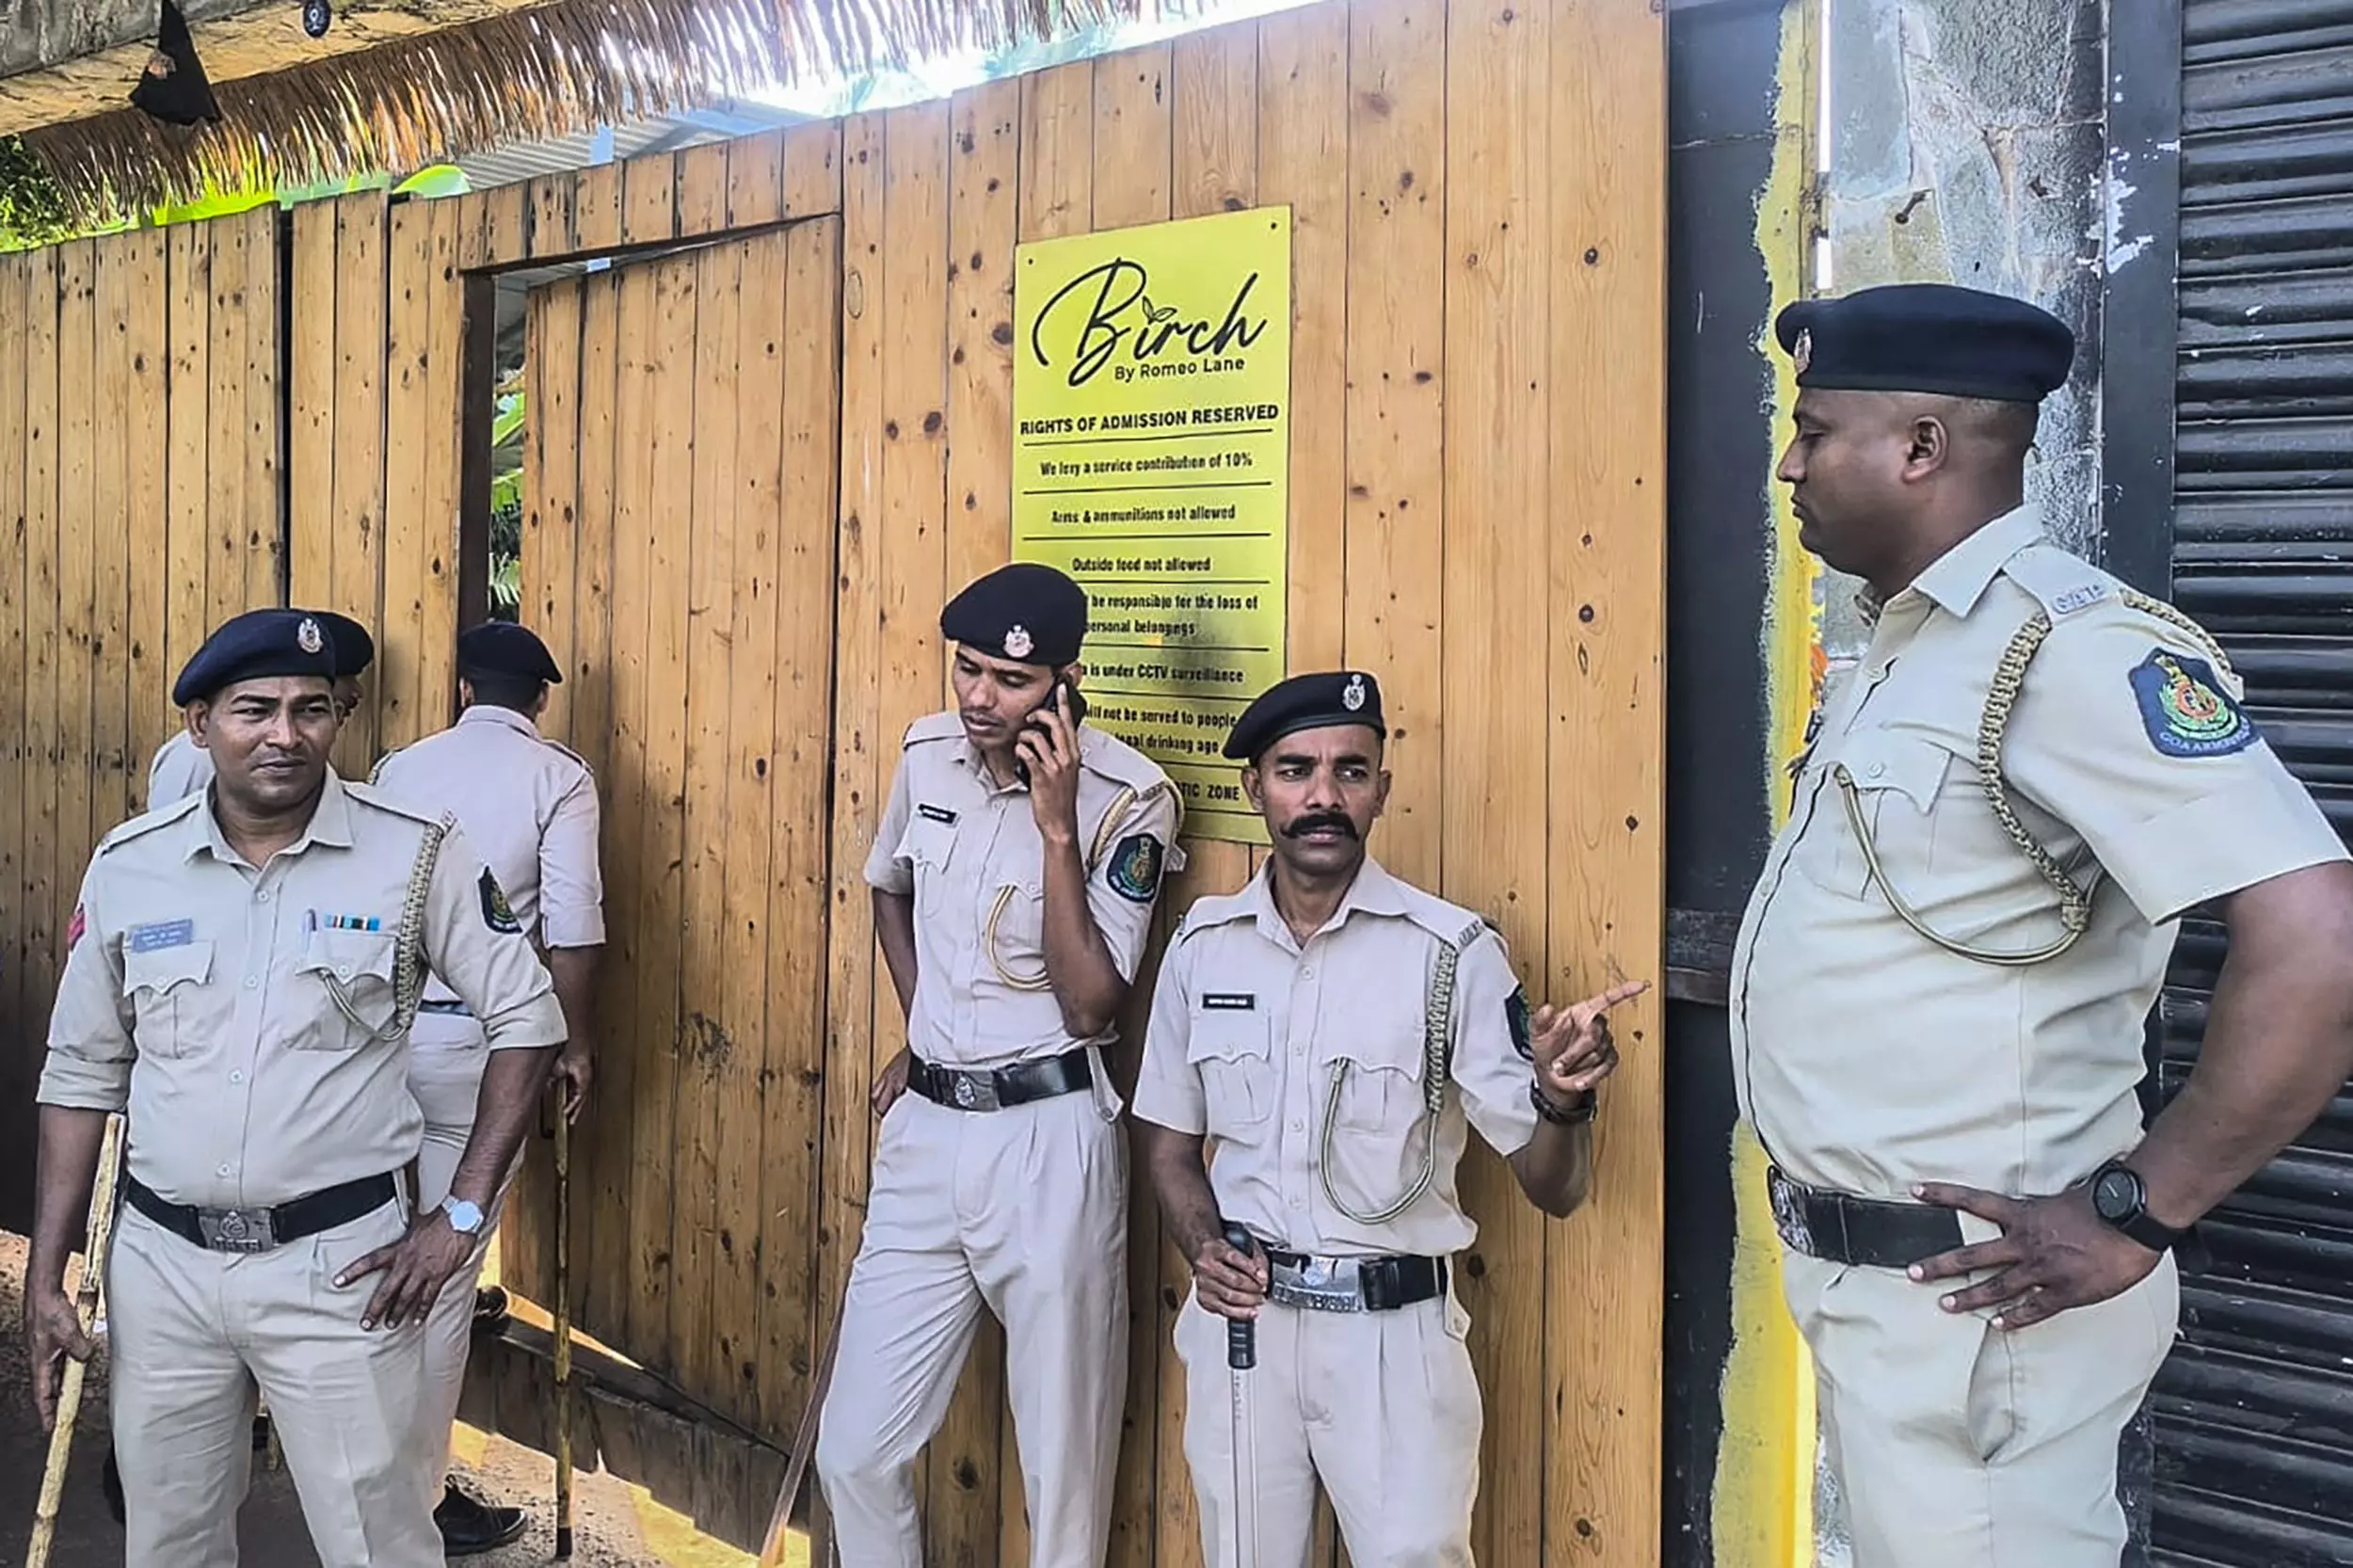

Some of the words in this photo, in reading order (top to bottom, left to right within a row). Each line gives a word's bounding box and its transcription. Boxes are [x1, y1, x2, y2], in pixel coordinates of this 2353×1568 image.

[1032, 257, 1267, 387] Birch
[1114, 366, 1135, 383] By
[1140, 362, 1197, 378] Romeo
[1203, 358, 1245, 373] Lane
[1020, 418, 1073, 435] RIGHTS
[1077, 417, 1096, 431] OF
[1100, 410, 1187, 430] ADMISSION
[1192, 405, 1278, 424] RESERVED
[1040, 462, 1056, 475] We
[1083, 462, 1091, 473] a
[1093, 457, 1132, 472] service
[1135, 455, 1206, 472] contribution
[1209, 454, 1222, 468] of
[1225, 452, 1253, 467] 10%
[1051, 509, 1079, 523] Arms
[1082, 509, 1091, 523] &
[1093, 505, 1164, 521] ammunitions
[1167, 506, 1186, 520] not
[1190, 504, 1236, 520] allowed
[1073, 557, 1113, 571] Outside
[1116, 557, 1141, 571] food
[1144, 558, 1162, 571] not
[1166, 556, 1211, 571] allowed
[1092, 594, 1105, 608] be
[1108, 593, 1172, 611] responsible
[1176, 595, 1192, 609] for
[1195, 594, 1214, 610] the
[1217, 595, 1242, 610] loss
[1245, 595, 1258, 610] of
[1134, 619, 1195, 637] belongings
[1090, 664, 1099, 677] is
[1102, 664, 1135, 678] under
[1137, 664, 1168, 680] CCTV
[1171, 666, 1244, 682] surveillance
[1103, 708, 1122, 722] not
[1124, 708, 1138, 723] be
[1141, 710, 1177, 725] served
[1180, 712, 1194, 726] to
[1146, 734, 1193, 753] drinking
[1196, 740, 1219, 755] age
[1207, 784, 1241, 801] ZONE
